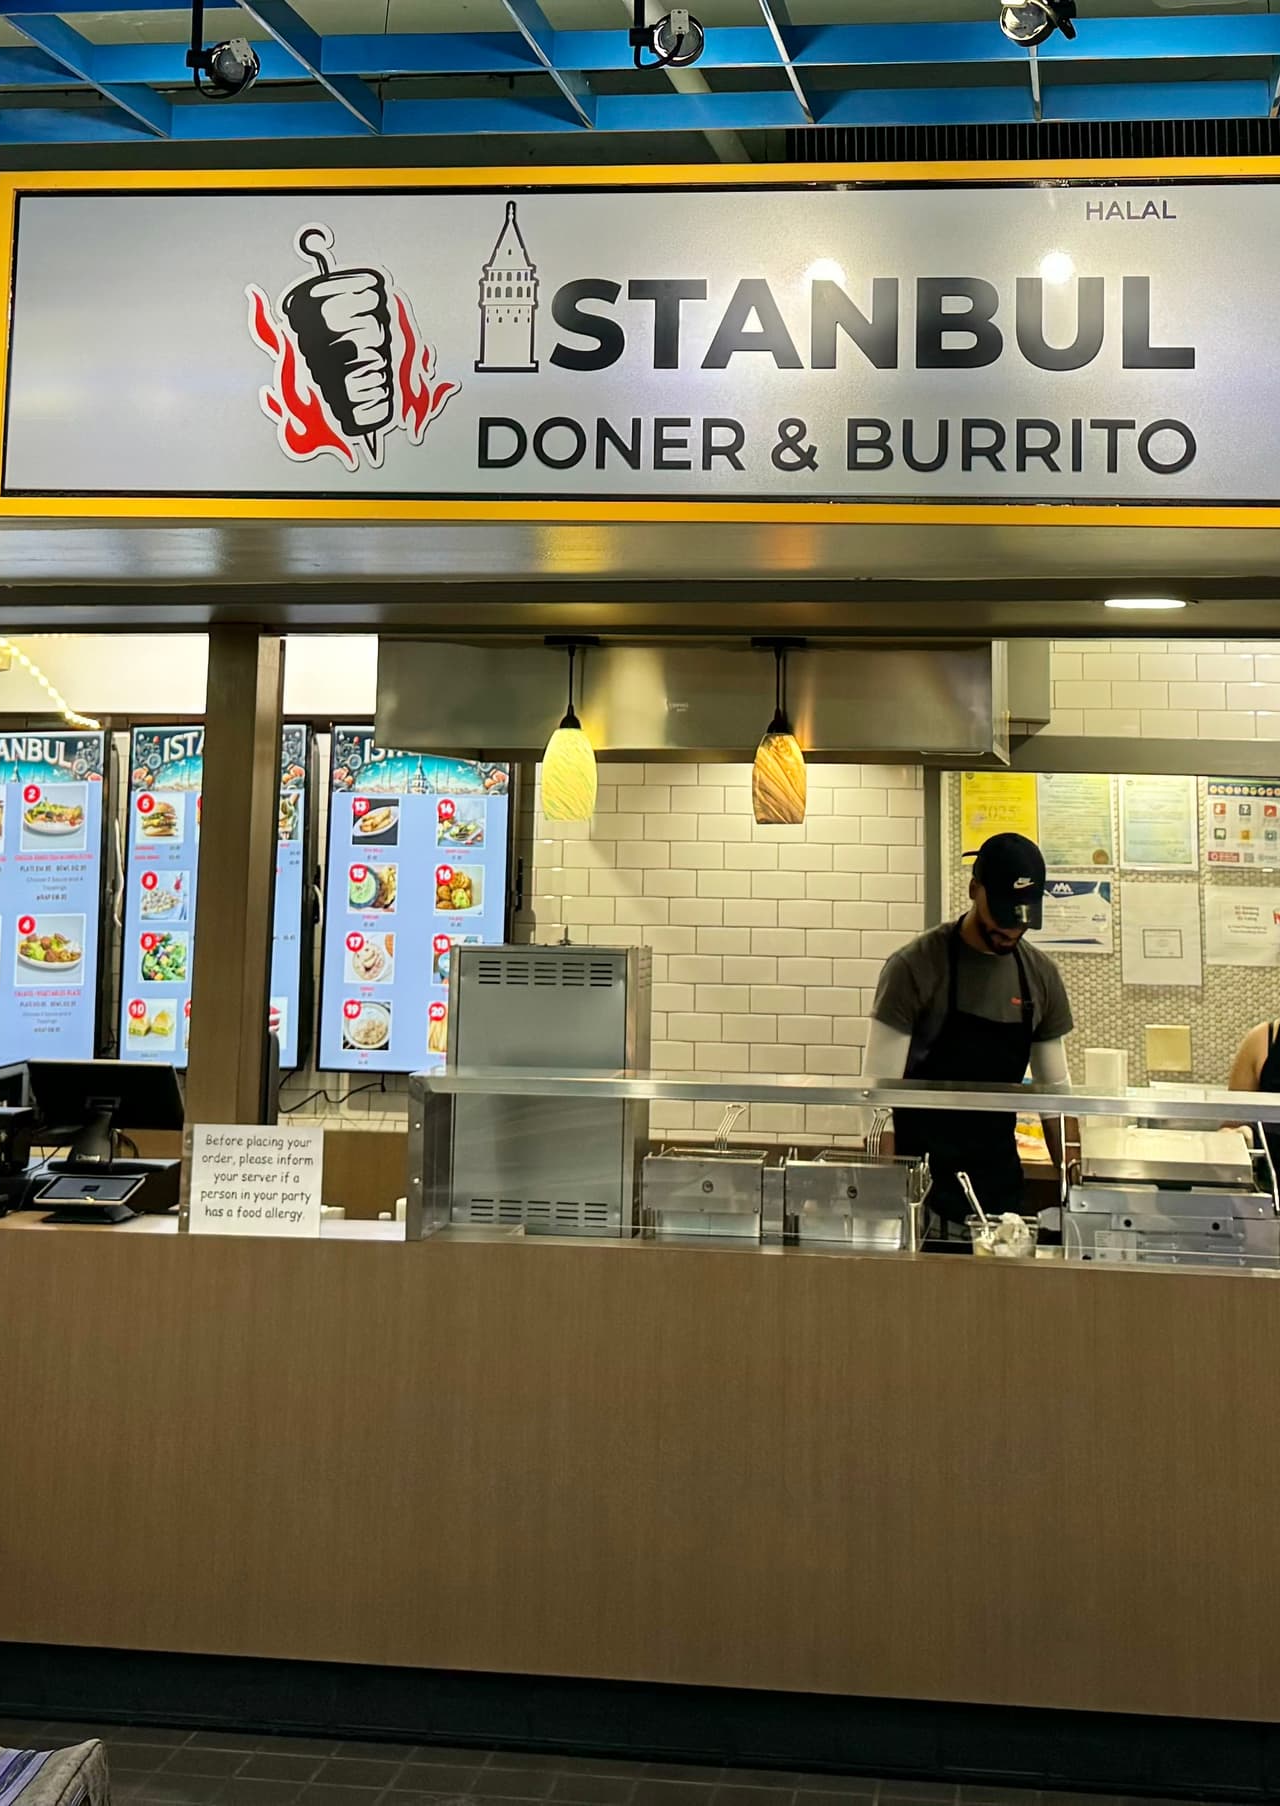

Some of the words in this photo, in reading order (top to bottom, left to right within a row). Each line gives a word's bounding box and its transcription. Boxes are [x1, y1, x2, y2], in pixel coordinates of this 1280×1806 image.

[1085, 200, 1179, 222] HALAL
[477, 416, 745, 473] DONER
[770, 416, 820, 474] &
[847, 416, 1197, 474] BURRITO
[27, 789, 36, 800] 2
[142, 798, 150, 810] 6
[352, 868, 364, 880] 15
[438, 869, 450, 881] 16
[21, 919, 31, 931] 4
[348, 937, 362, 948] 17
[435, 938, 448, 950] 18
[130, 1003, 144, 1016] 10
[346, 1005, 359, 1016] 19
[431, 1006, 444, 1017] 20
[205, 1134, 243, 1146] Before
[246, 1135, 284, 1150] placing
[287, 1139, 313, 1149] your
[202, 1153, 236, 1165] order,
[239, 1153, 273, 1166] please
[277, 1154, 314, 1165] inform
[214, 1172, 238, 1184] your
[241, 1173, 278, 1183] server
[280, 1172, 291, 1183] if
[200, 1190, 237, 1202] person
[241, 1190, 250, 1199] in
[253, 1192, 278, 1203] your
[281, 1191, 312, 1204] party
[205, 1205, 223, 1217] has
[237, 1206, 262, 1218] food
